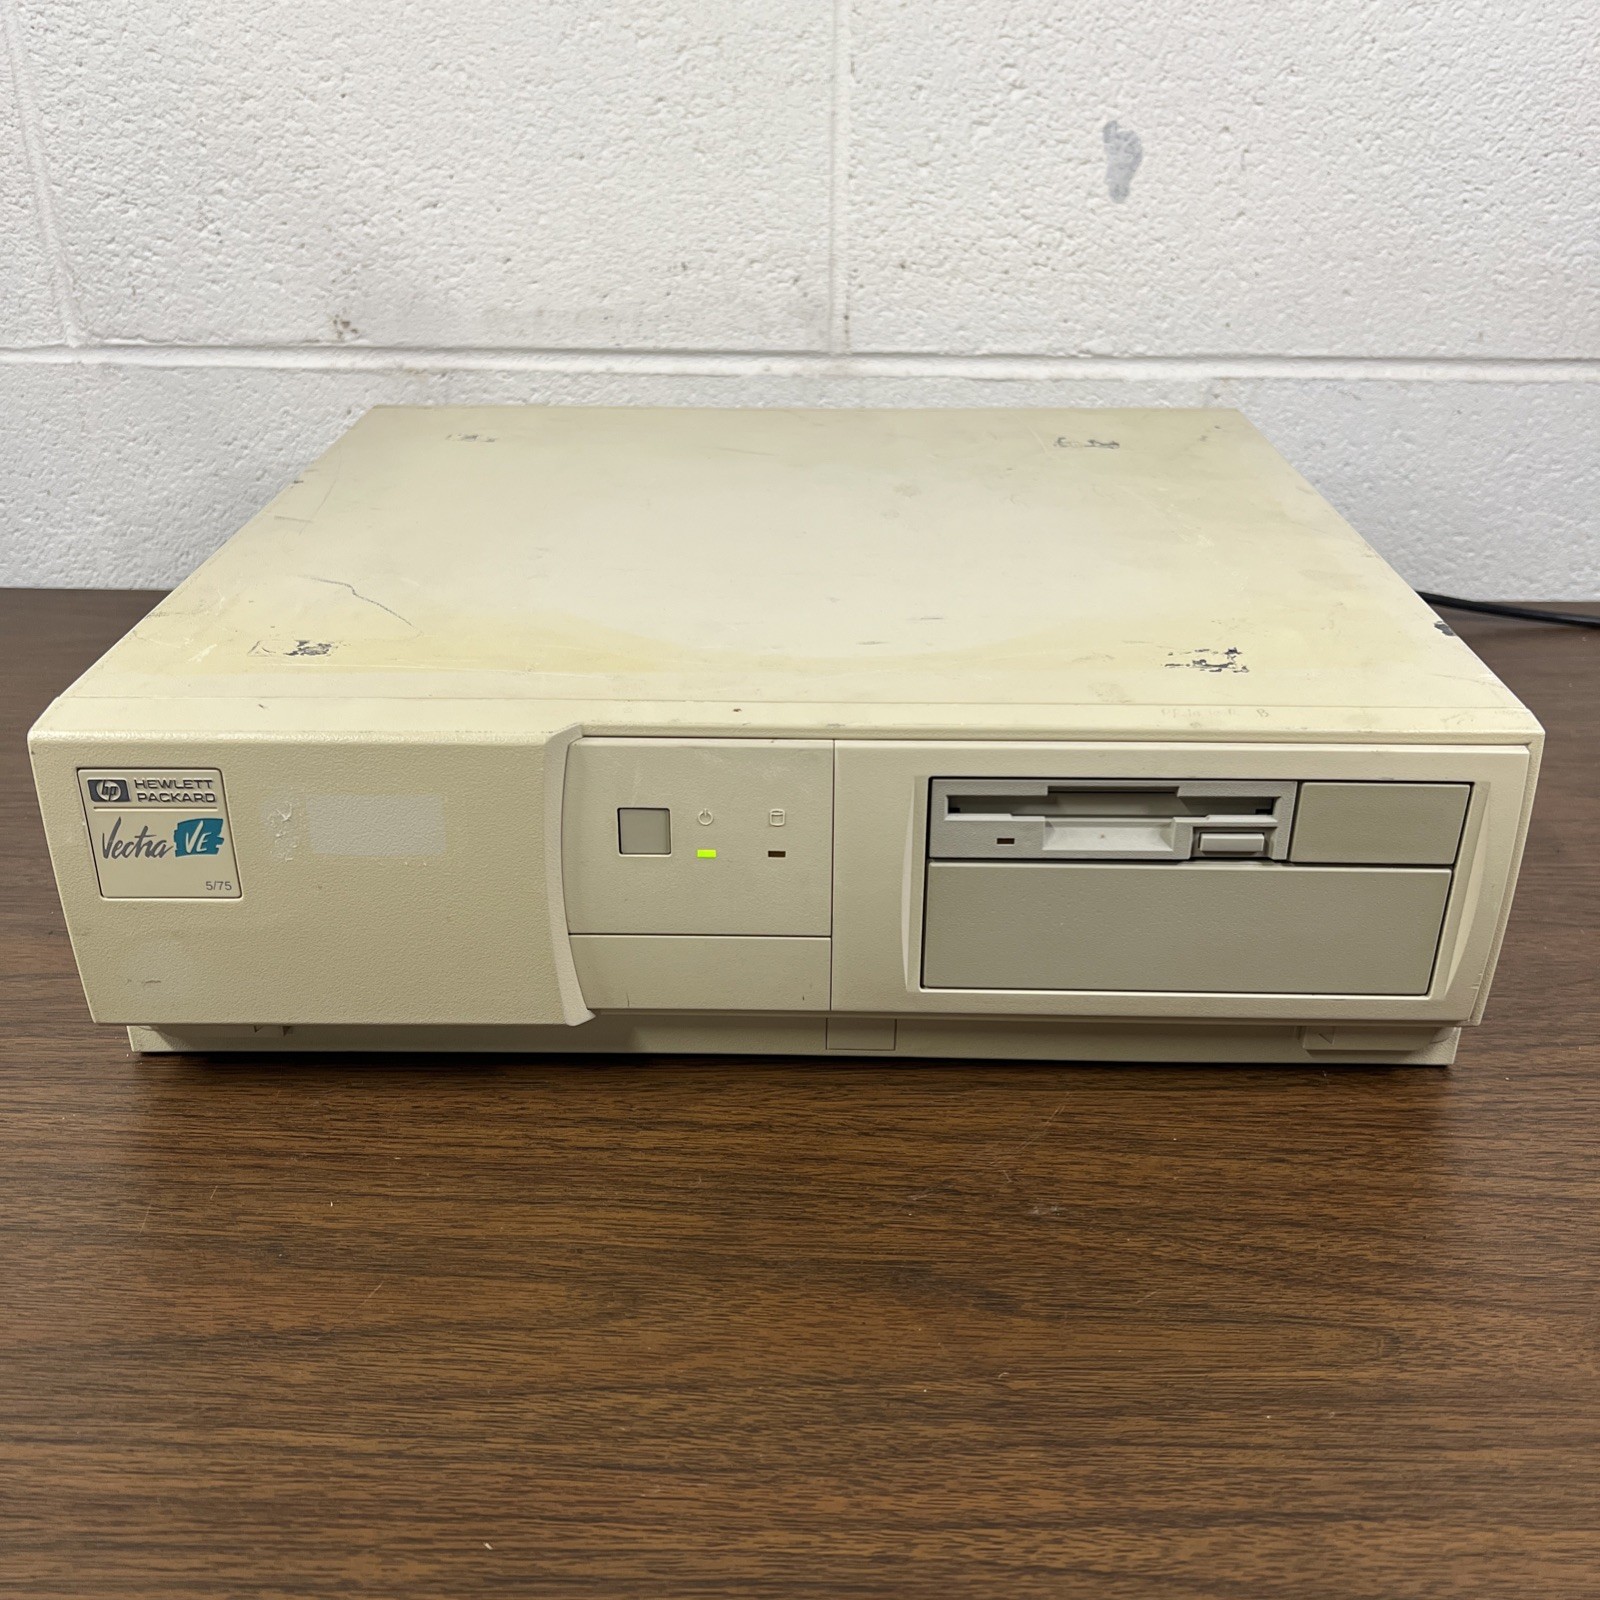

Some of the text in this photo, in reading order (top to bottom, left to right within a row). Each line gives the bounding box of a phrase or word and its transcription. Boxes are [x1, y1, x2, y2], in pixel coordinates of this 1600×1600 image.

[134, 779, 213, 789] HEWLETT
[100, 780, 121, 801] hp
[137, 793, 216, 803] PACKARD
[102, 816, 212, 859] Vectra VE
[205, 881, 232, 891] 5/75
